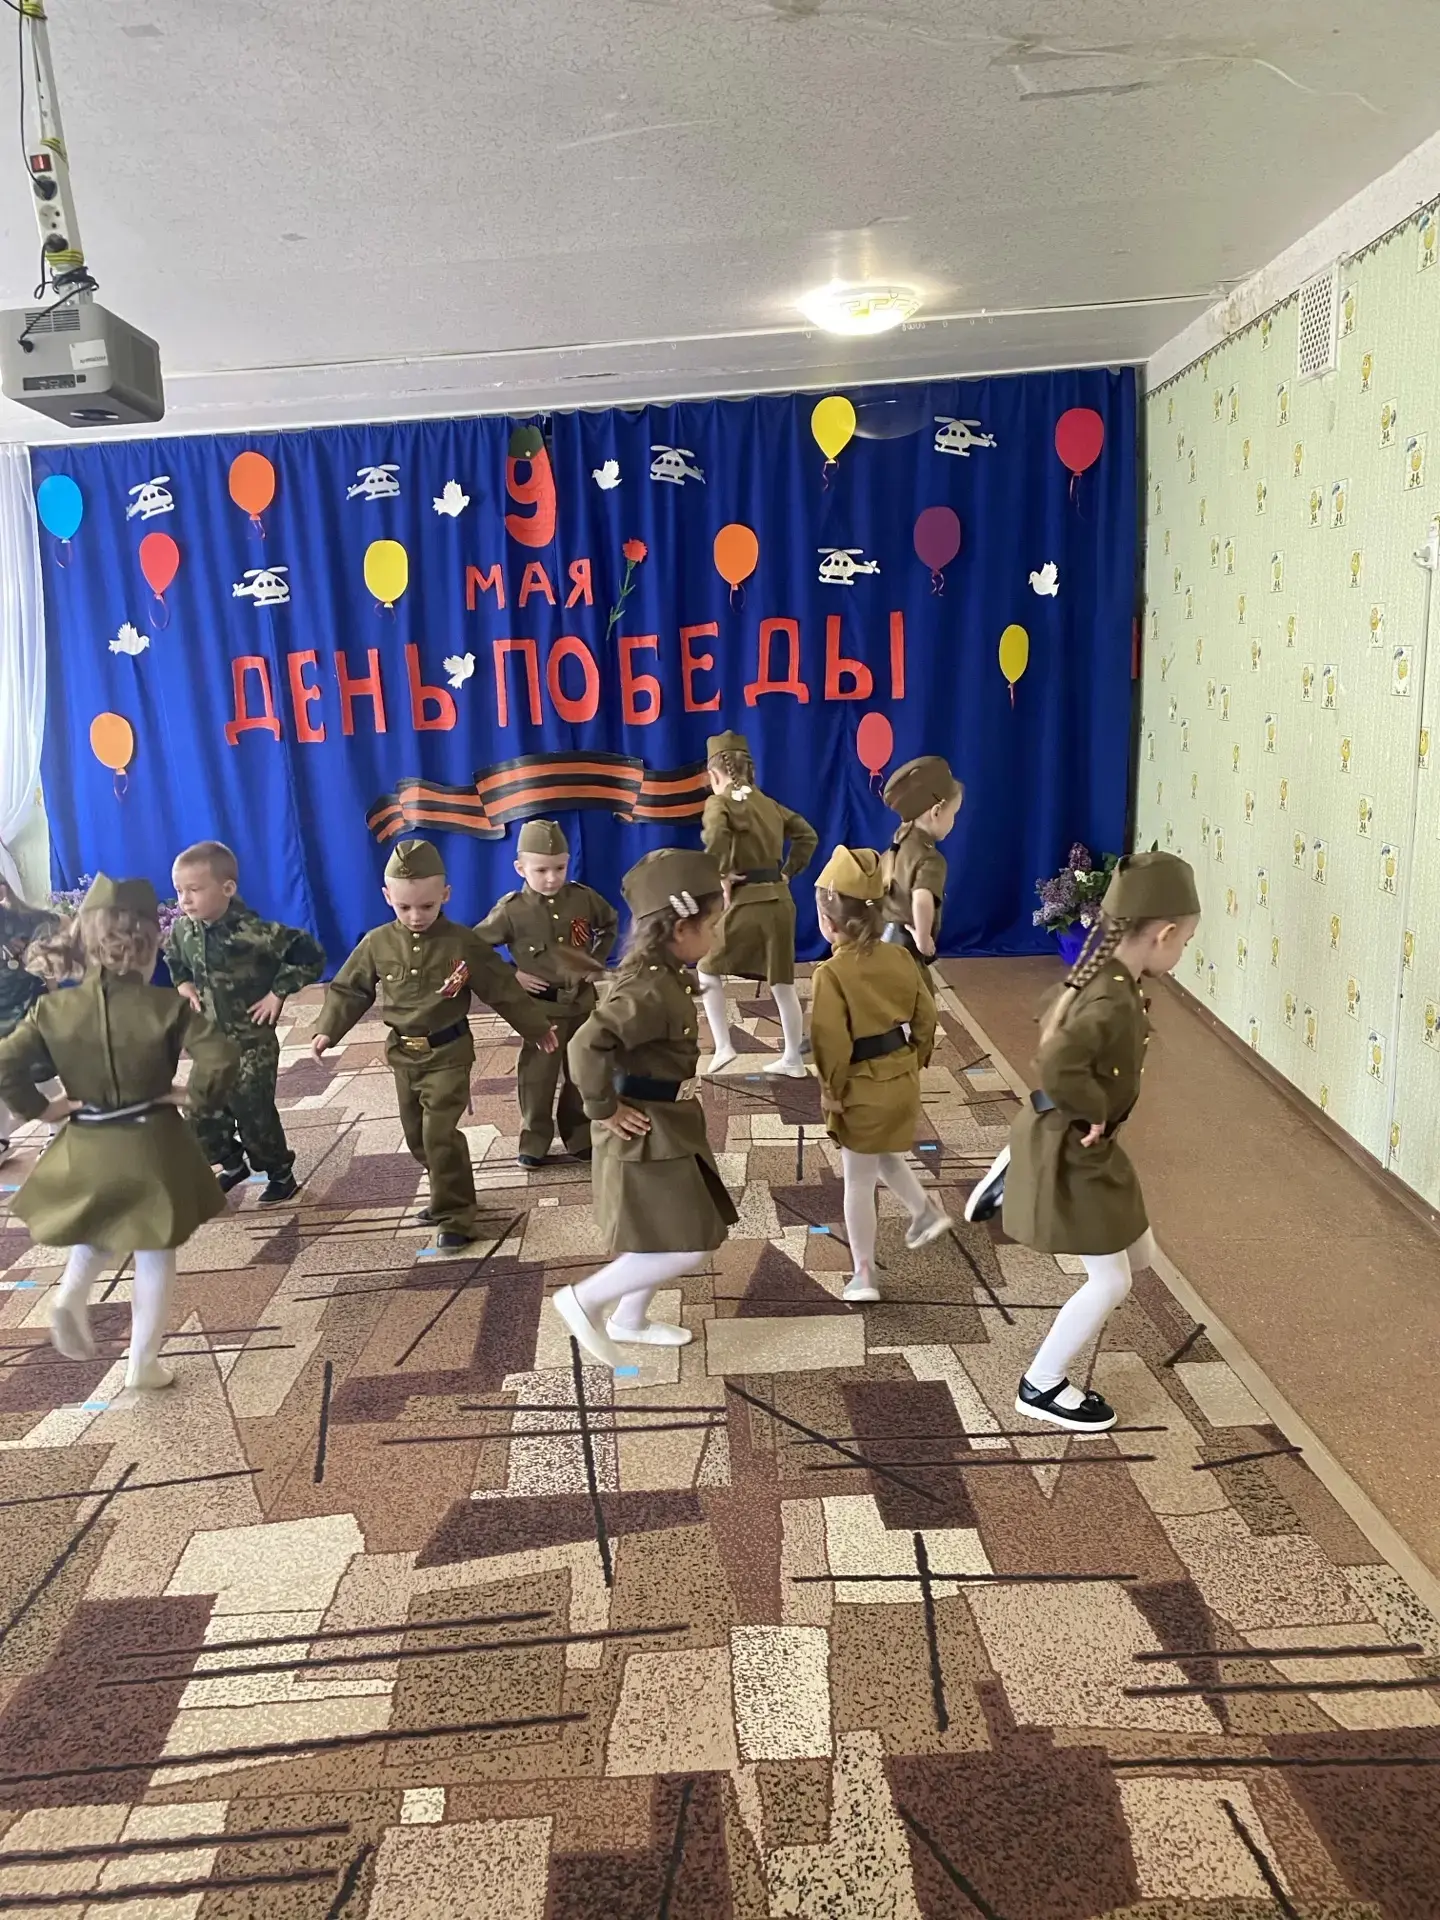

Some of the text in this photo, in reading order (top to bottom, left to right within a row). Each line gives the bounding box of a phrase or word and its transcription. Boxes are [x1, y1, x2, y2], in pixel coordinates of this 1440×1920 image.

[505, 444, 557, 547] 9
[466, 558, 593, 610] МАЯ
[224, 611, 904, 745] ДЕНЬ ПОБЕДЫ
